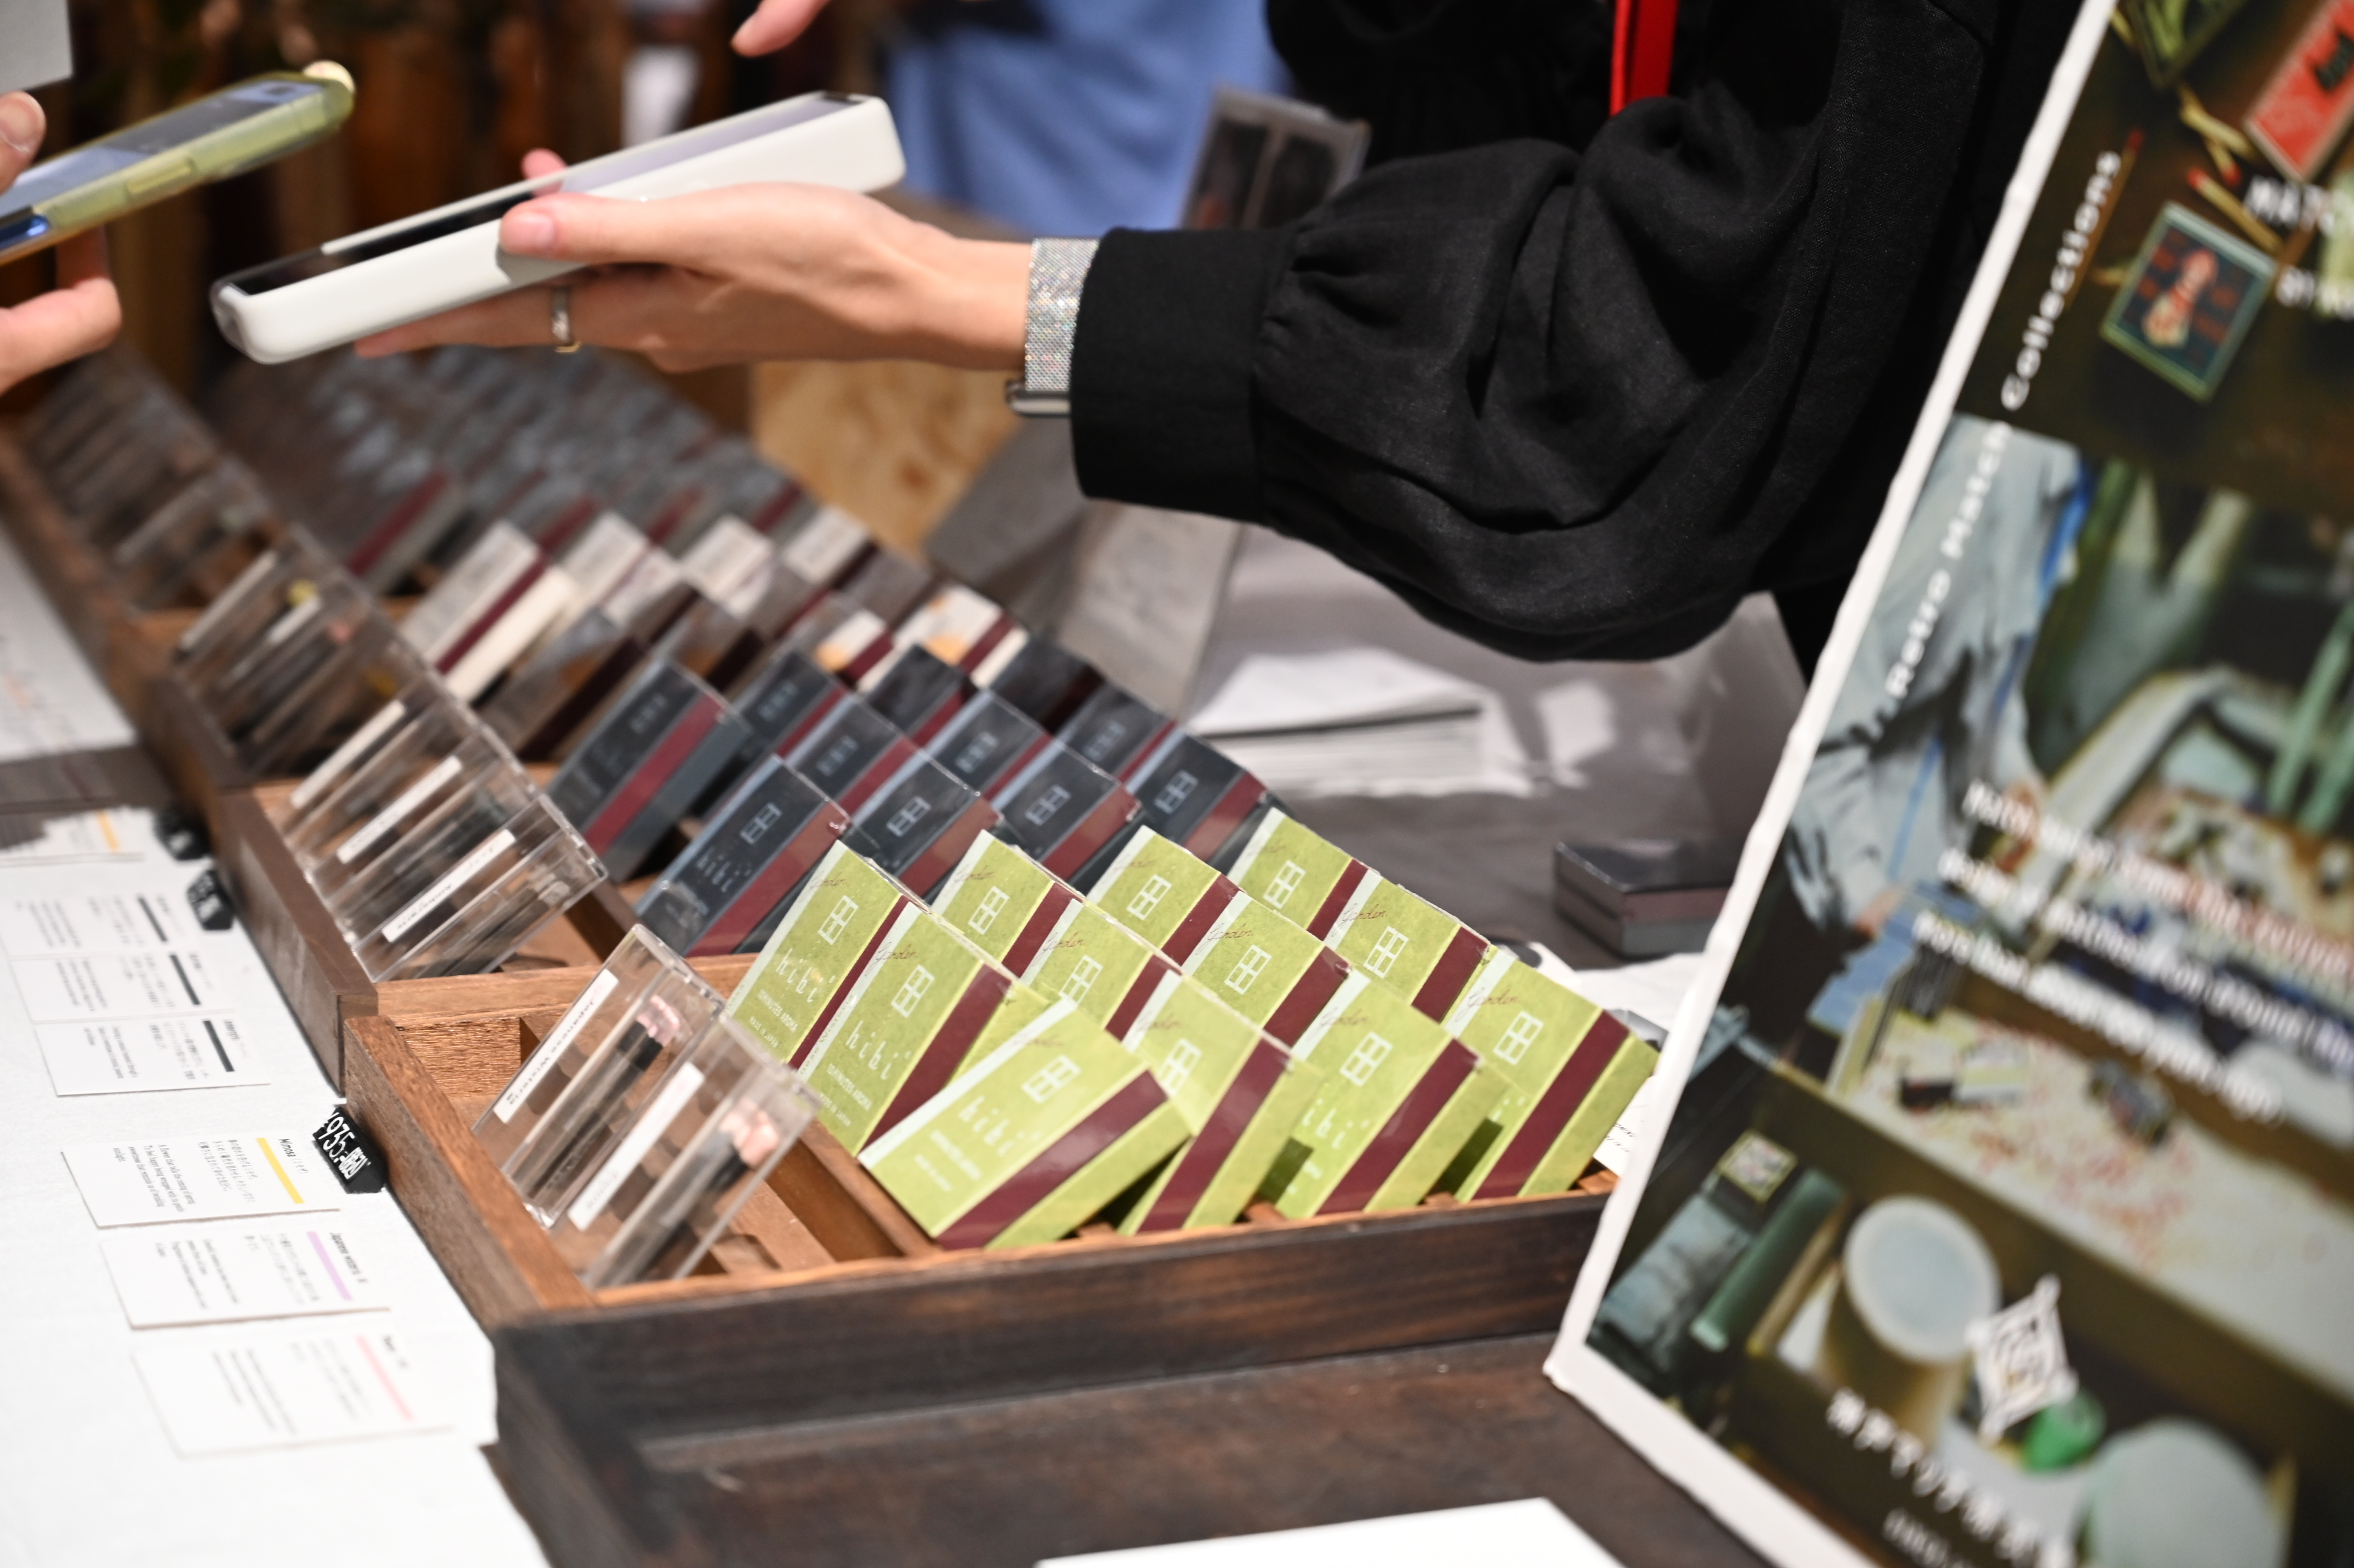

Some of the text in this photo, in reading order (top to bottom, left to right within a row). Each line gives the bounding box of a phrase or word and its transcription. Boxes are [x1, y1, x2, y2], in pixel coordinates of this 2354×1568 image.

[1884, 149, 2122, 700] Retro Match Collections
[775, 949, 823, 1003] hibi
[780, 1011, 799, 1033] AROMA
[764, 1031, 779, 1048] JAPAN
[845, 1020, 899, 1080] hibi
[508, 998, 595, 1107] Japanese Wisteria
[958, 1095, 1025, 1156] hibi
[1303, 1097, 1354, 1150] ibi
[127, 1146, 143, 1163] sweetness
[159, 1147, 173, 1158] flower
[277, 1138, 297, 1157] Mimosa
[148, 1157, 162, 1167] happy
[153, 1167, 167, 1177] being
[158, 1177, 174, 1190] wrapped
[329, 1232, 352, 1254] Japanese
